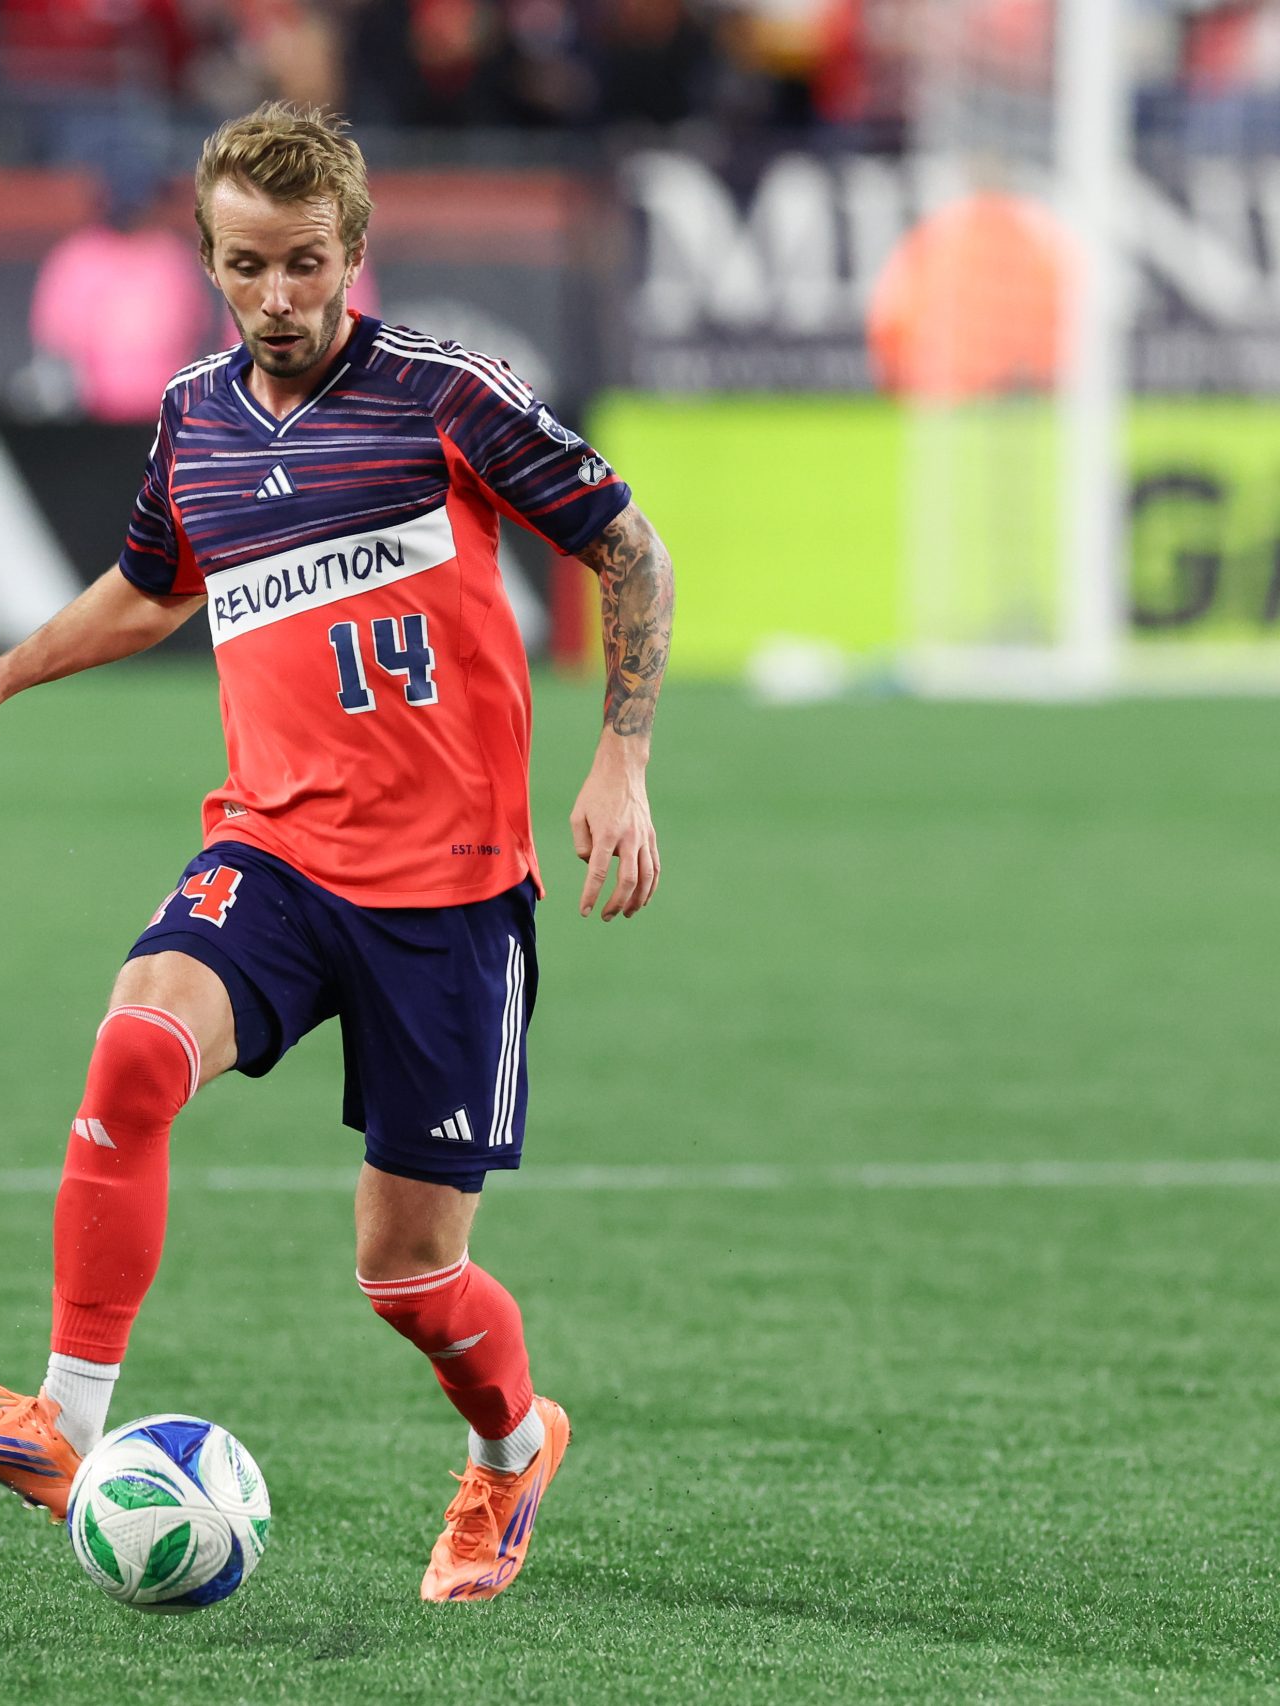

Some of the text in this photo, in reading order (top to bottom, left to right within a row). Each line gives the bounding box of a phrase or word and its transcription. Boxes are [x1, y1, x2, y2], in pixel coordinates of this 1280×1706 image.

[214, 535, 405, 631] REVOLUTION
[328, 613, 439, 715] 14
[451, 844, 501, 856] EST. 1996
